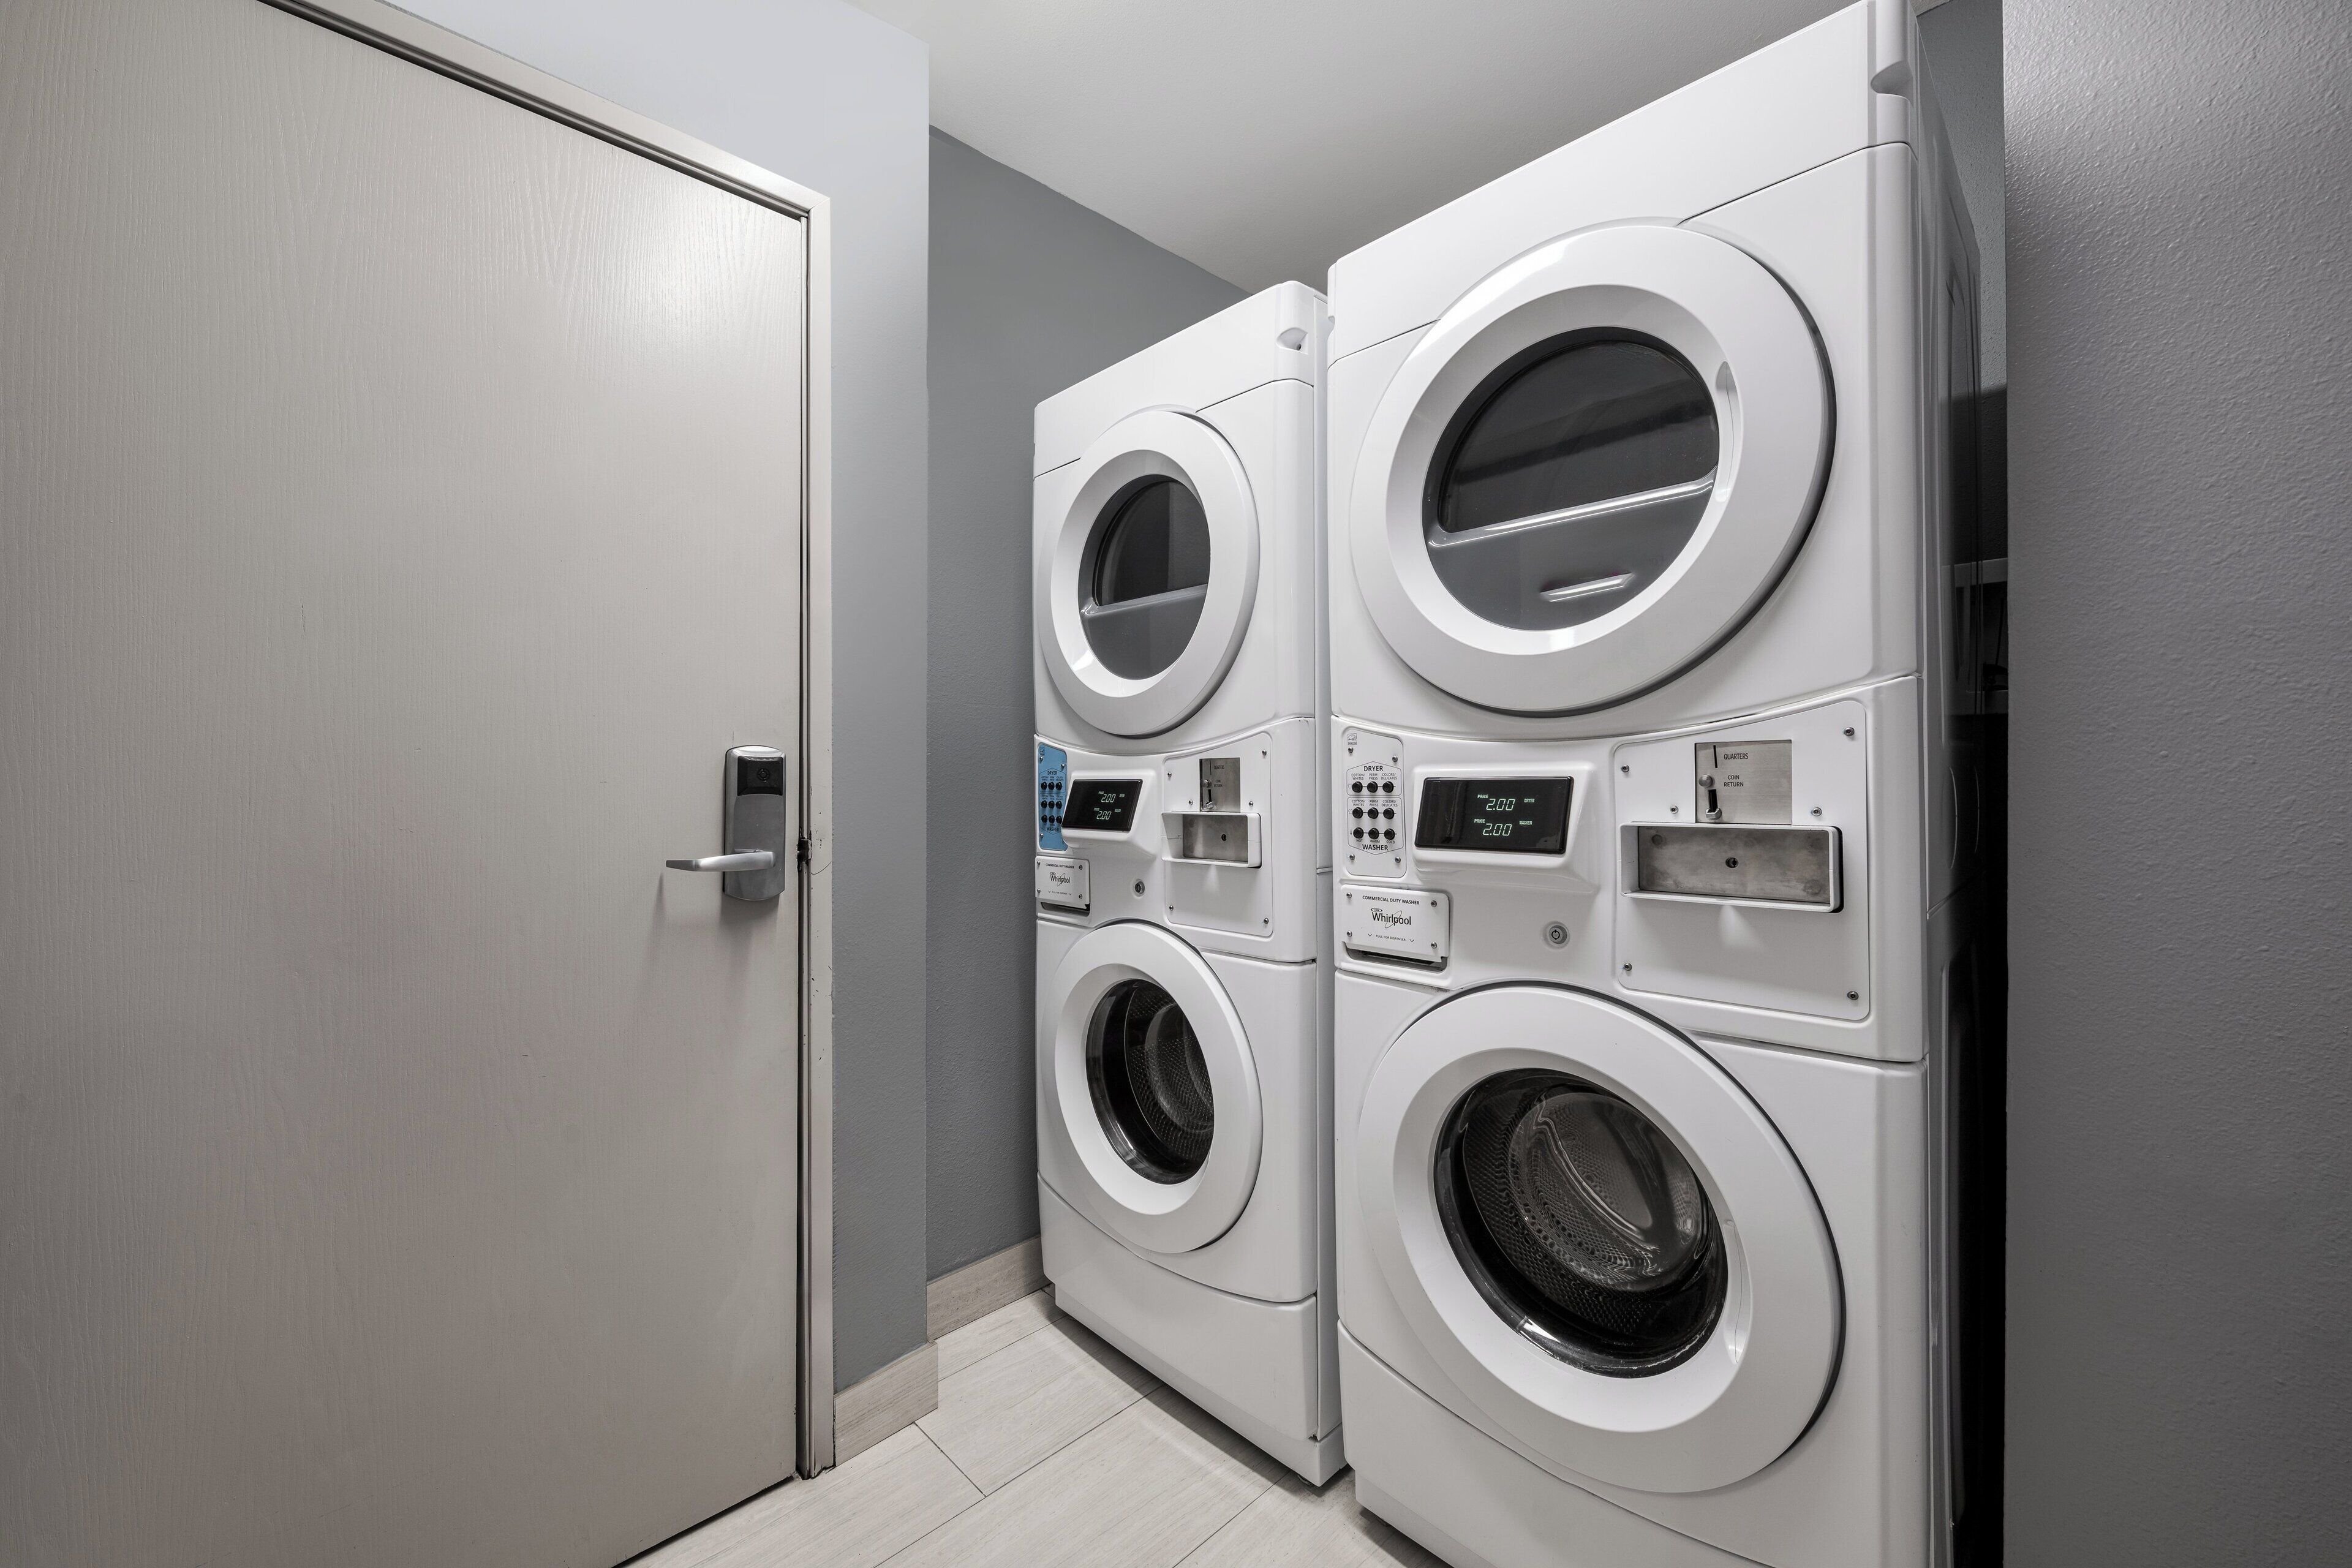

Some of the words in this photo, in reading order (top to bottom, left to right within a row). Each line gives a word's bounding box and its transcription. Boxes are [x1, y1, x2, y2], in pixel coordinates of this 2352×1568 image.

[1101, 794, 1116, 803] 2.00
[1486, 798, 1515, 811] 2.00
[1096, 810, 1112, 820] 2.00
[1482, 823, 1512, 836] 2.00
[1050, 875, 1071, 884] Whirlpool
[1371, 911, 1411, 926] Whirlpool
